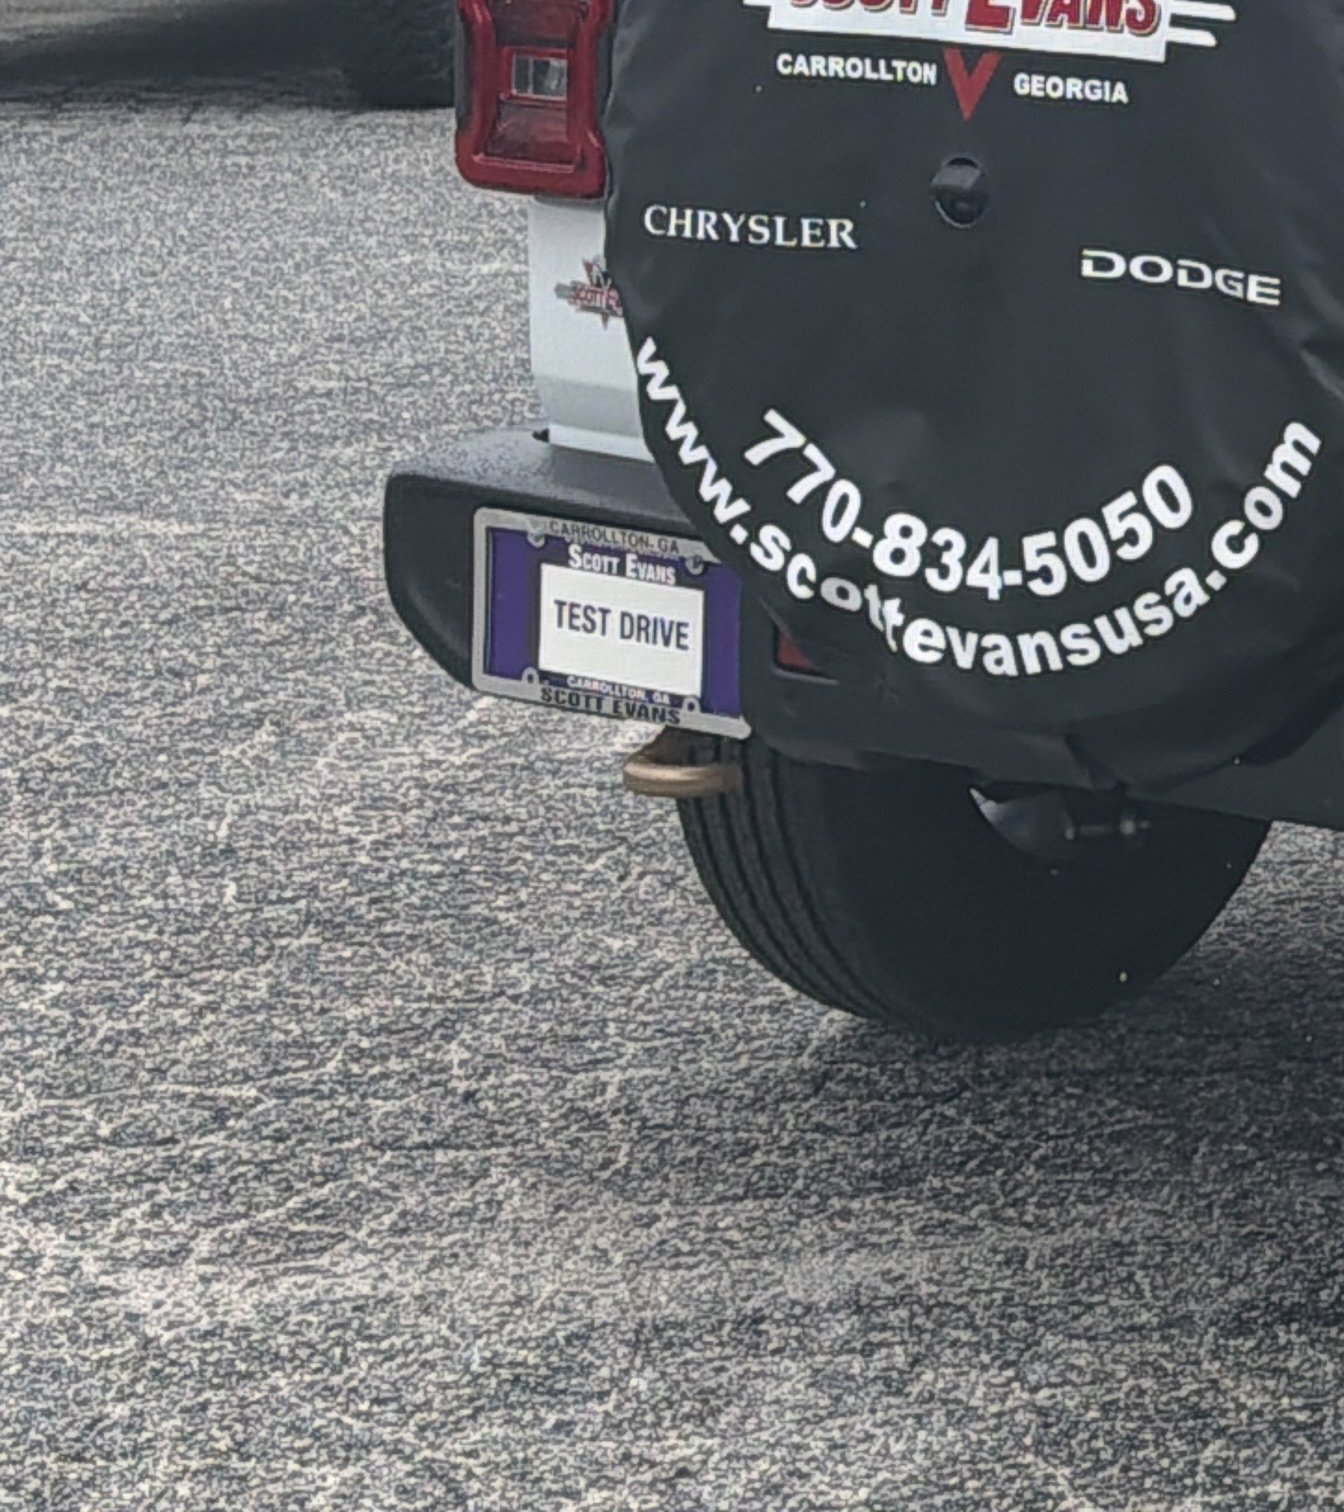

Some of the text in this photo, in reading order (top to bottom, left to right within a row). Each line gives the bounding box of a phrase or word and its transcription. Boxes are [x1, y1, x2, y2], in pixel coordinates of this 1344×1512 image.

[775, 52, 938, 87] CARROLLTON
[1012, 72, 1129, 104] GEORGIA
[643, 203, 859, 250] CHRYSLER
[1080, 249, 1281, 307] DODGE
[636, 337, 1322, 678] www.scottevansusa.com
[743, 408, 1194, 600] 770-834-5050
[657, 537, 680, 554] GA
[553, 598, 690, 651] TEST DRIVE
[540, 686, 682, 725] SCOTT EVANS
